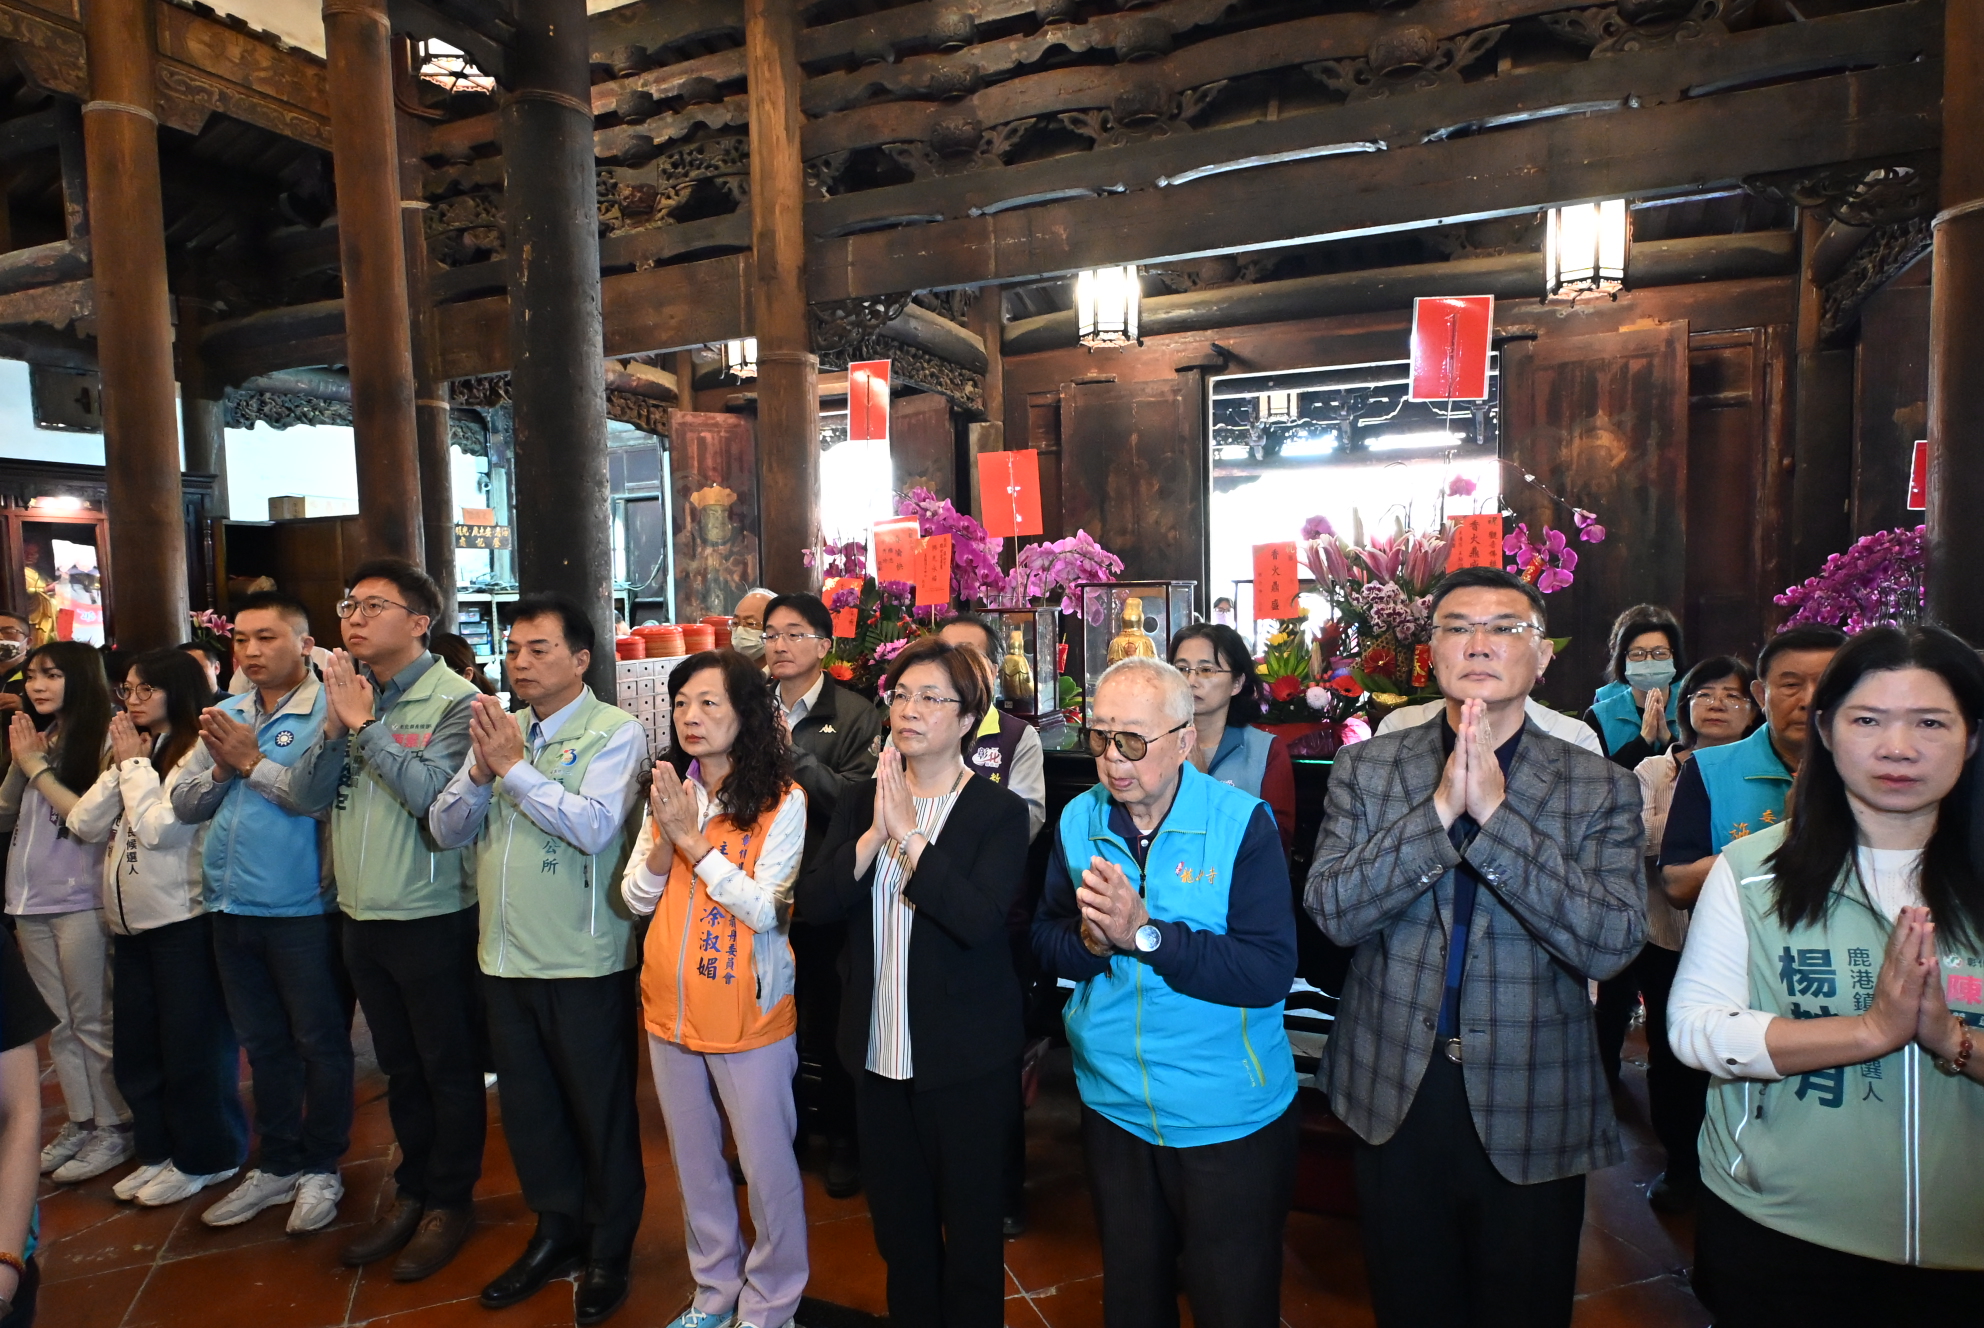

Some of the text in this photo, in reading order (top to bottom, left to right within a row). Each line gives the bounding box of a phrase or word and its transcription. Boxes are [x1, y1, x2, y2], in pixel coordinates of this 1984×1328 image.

[1271, 548, 1281, 611] 香火鼎盛
[541, 837, 561, 875] 公所
[1946, 974, 1983, 1005] 陳
